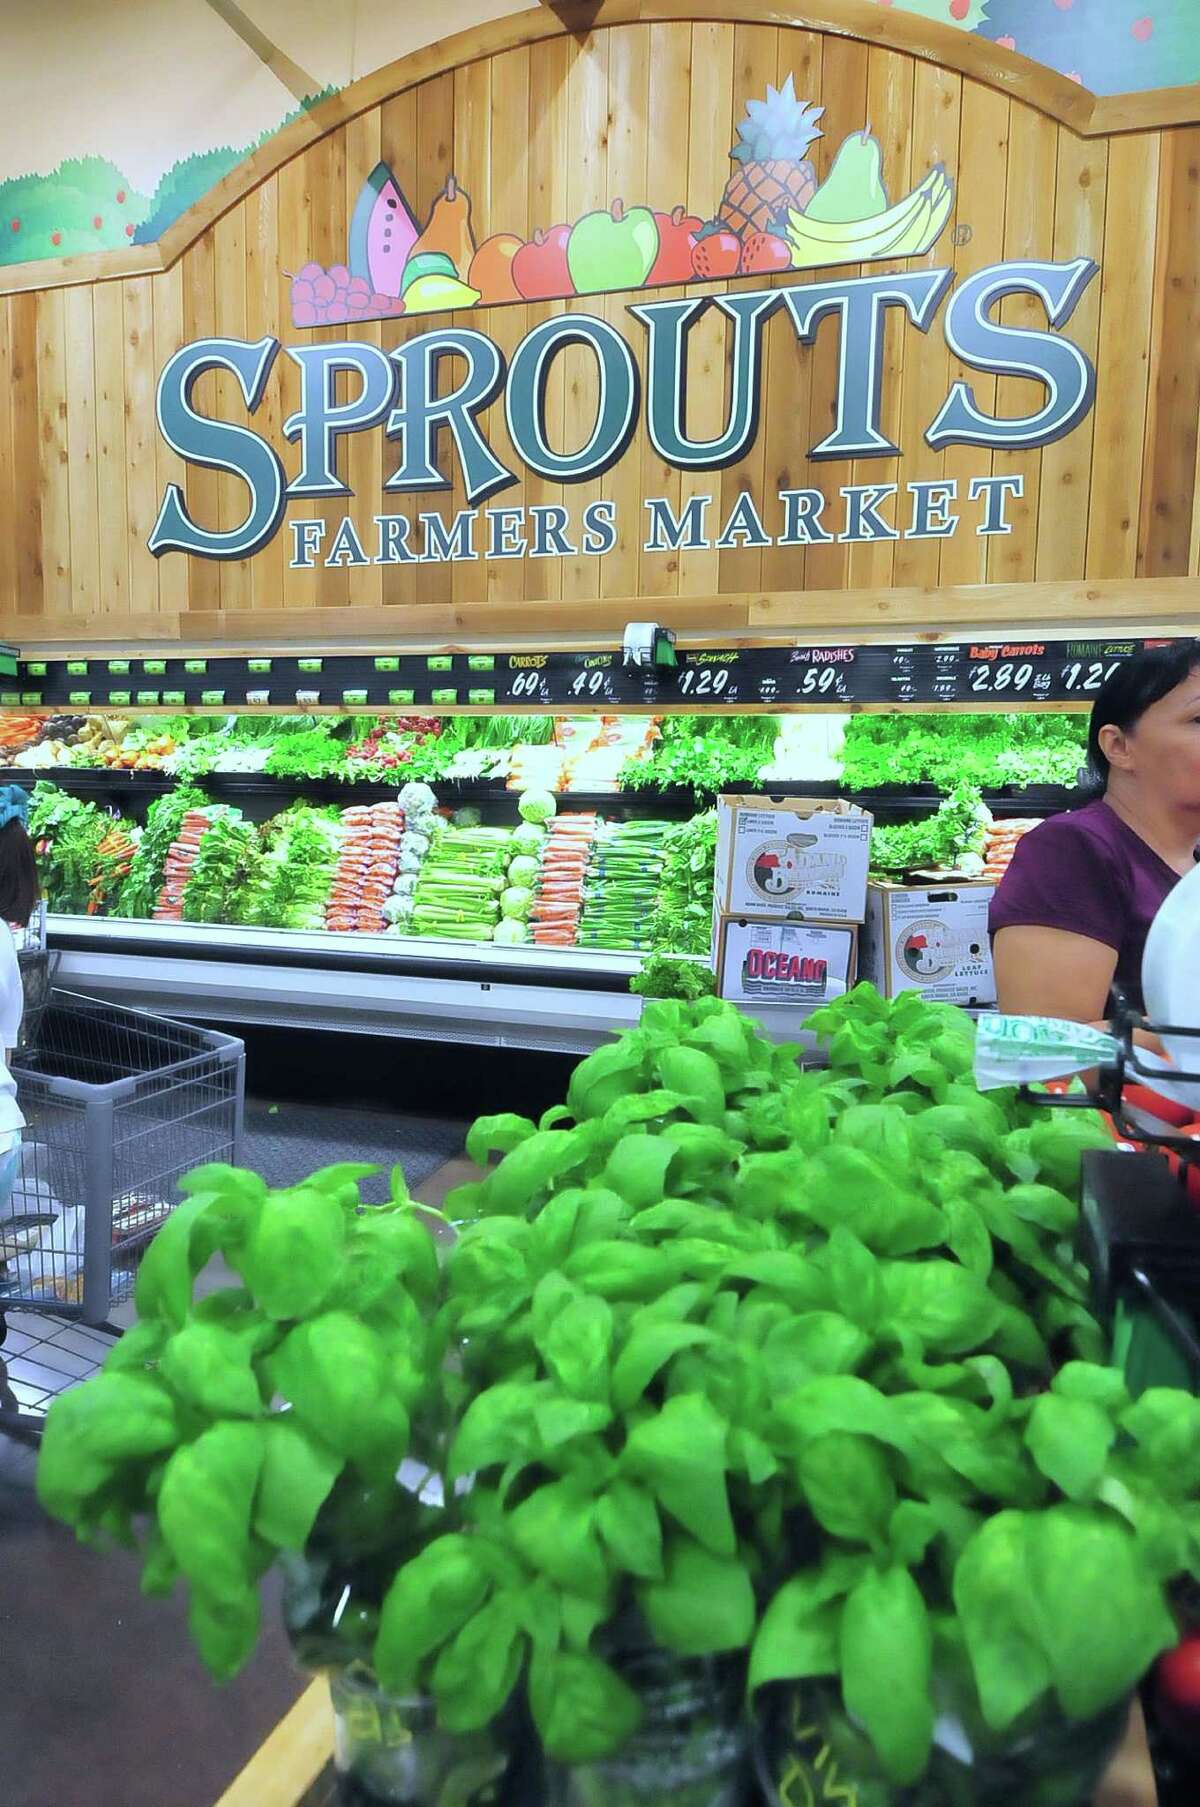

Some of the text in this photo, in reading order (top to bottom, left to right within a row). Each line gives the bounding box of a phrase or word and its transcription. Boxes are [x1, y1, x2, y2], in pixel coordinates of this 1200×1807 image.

[149, 258, 1099, 559] SPROUTS
[289, 473, 1026, 570] FARMERS MARKET
[812, 648, 855, 663] RADISHES
[969, 645, 999, 661] Baby
[1001, 644, 1045, 657] Carrots
